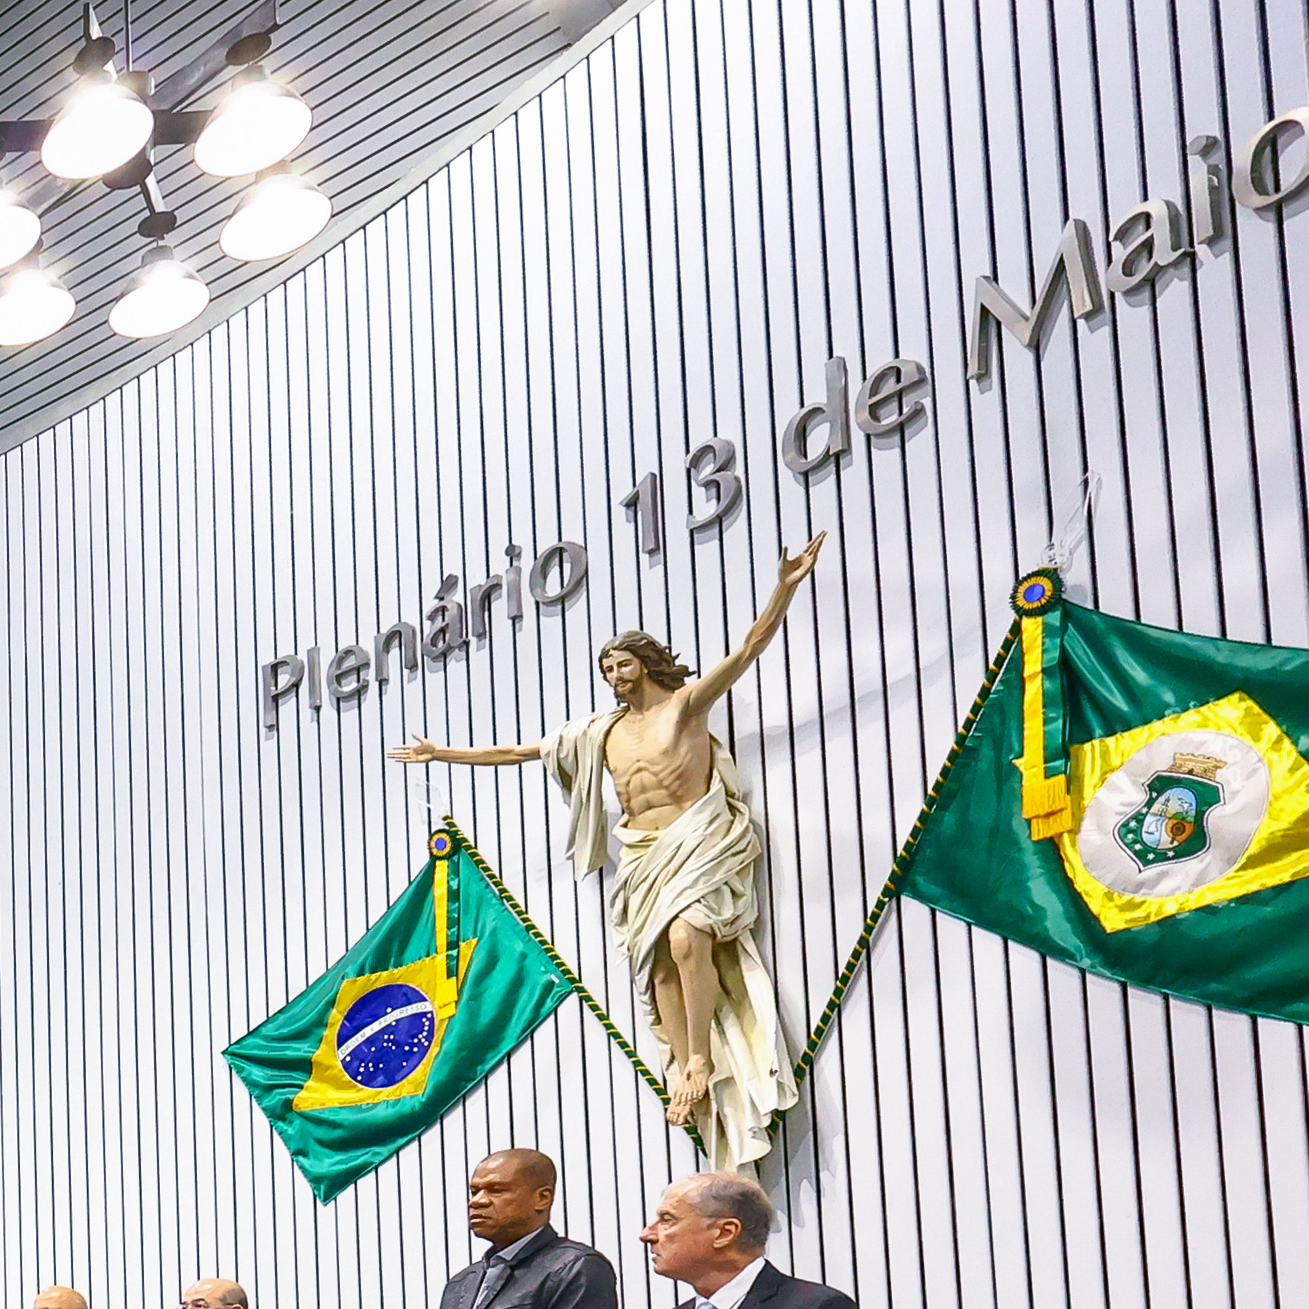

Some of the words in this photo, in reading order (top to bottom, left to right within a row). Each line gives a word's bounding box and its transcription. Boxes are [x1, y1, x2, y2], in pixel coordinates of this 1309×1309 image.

[261, 540, 589, 730] Plenário
[619, 437, 744, 555] 13
[781, 355, 929, 474] de
[966, 106, 1309, 382] Maio
[339, 1031, 367, 1056] ORDEM
[378, 1003, 428, 1026] PROGRESSO
